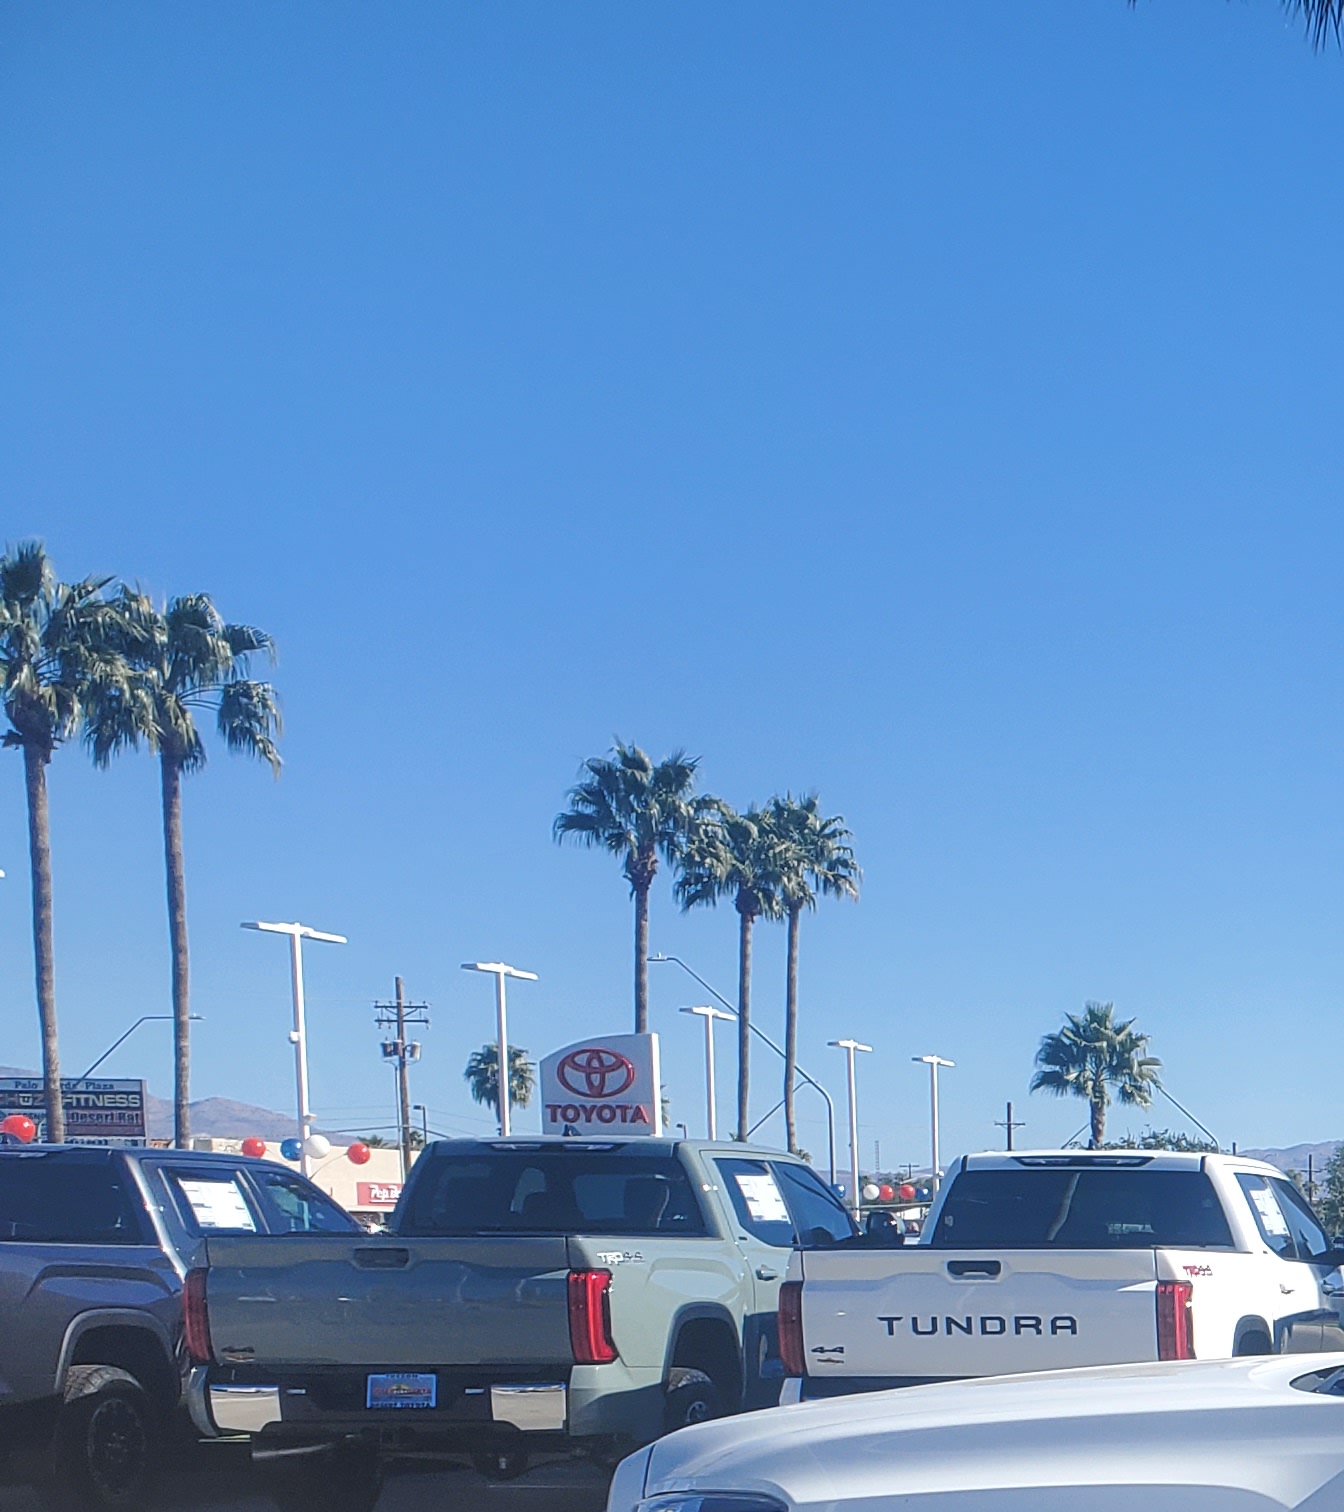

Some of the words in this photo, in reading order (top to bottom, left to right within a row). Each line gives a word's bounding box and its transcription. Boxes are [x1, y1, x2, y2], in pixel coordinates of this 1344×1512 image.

[14, 1080, 38, 1089] Palo
[85, 1082, 115, 1090] Plaza
[62, 1094, 140, 1107] FITNESS
[545, 1103, 648, 1124] TOYOTA
[877, 1316, 1077, 1335] TUNDRA
